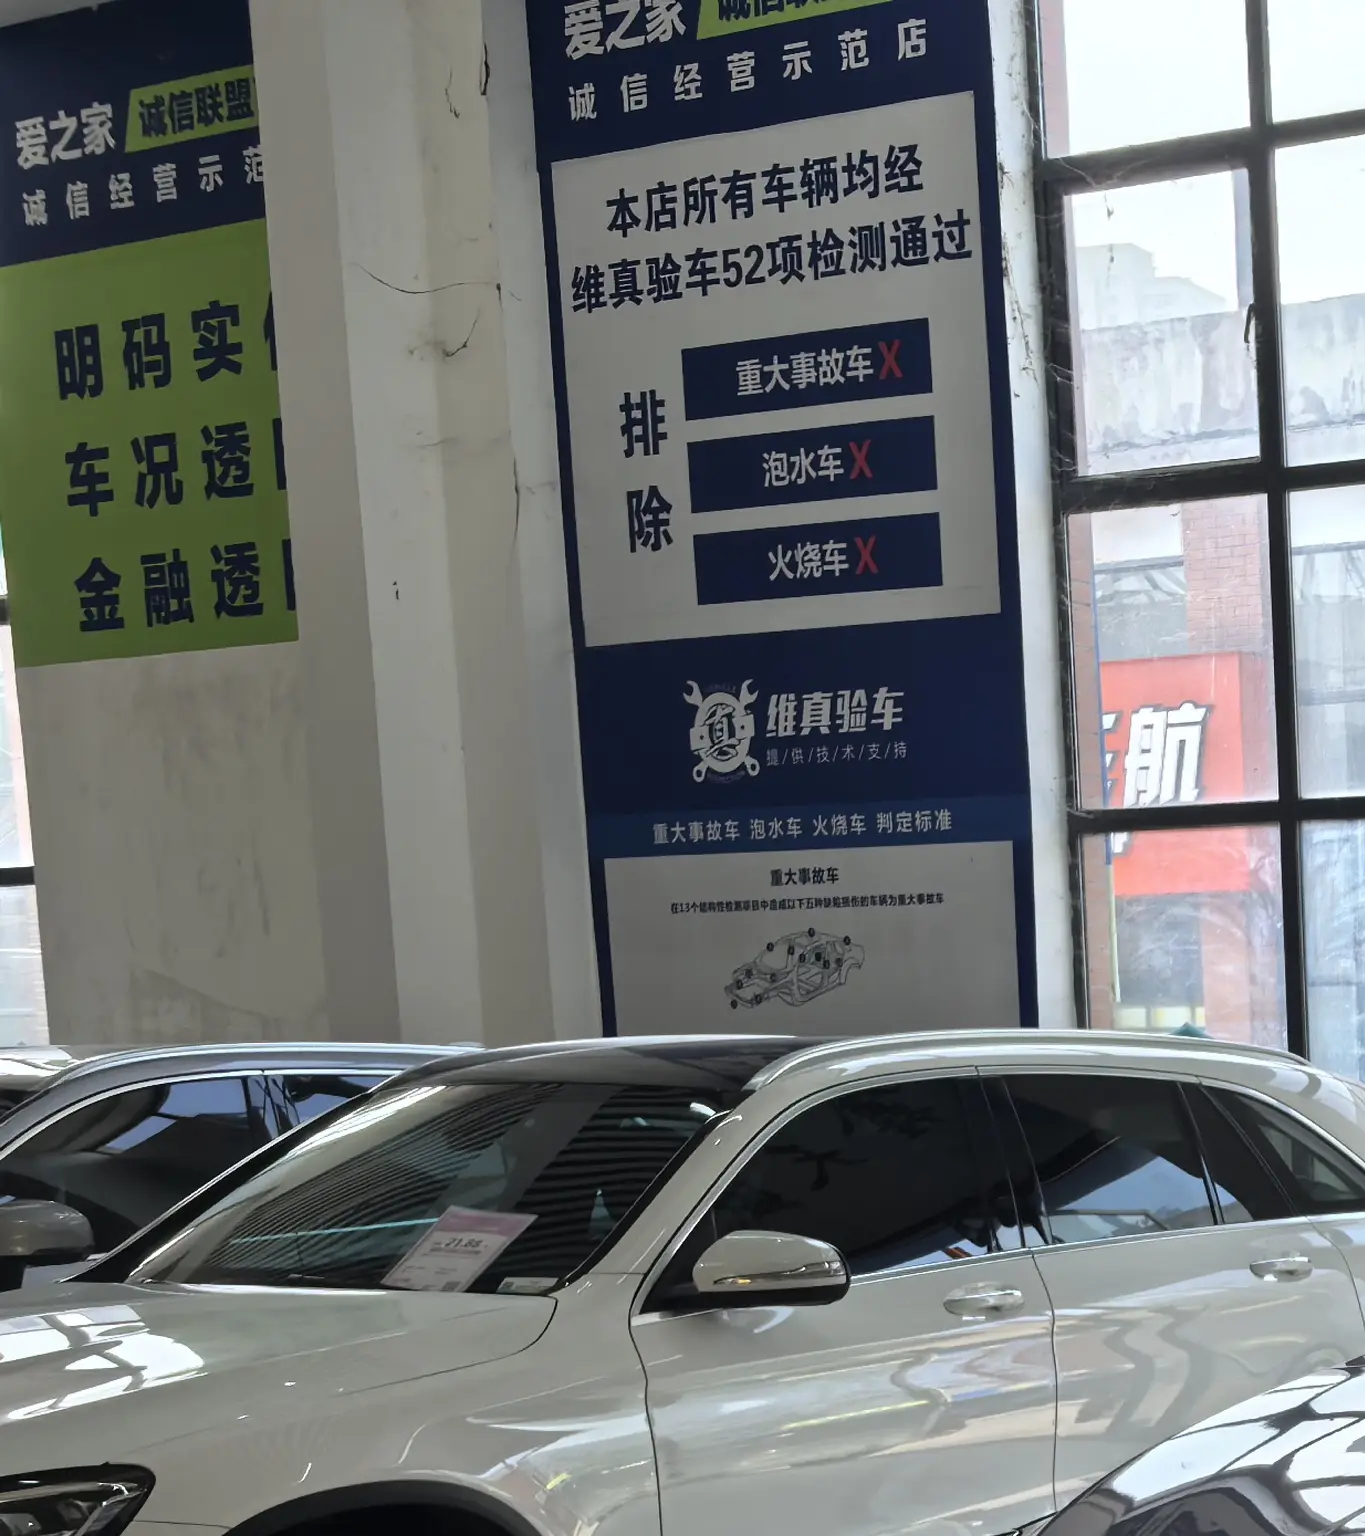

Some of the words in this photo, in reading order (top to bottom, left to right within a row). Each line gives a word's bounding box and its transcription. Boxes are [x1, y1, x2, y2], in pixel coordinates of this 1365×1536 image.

[563, 0, 687, 60] 爱之家
[567, 17, 928, 121] 诚信经营示范店
[14, 103, 117, 169] 爱之家
[138, 77, 255, 137] 诚信联盟
[22, 144, 264, 226] 诚信经营示范
[605, 143, 924, 238] 本店所有车辆均经
[570, 208, 973, 314] 维真验车52项检测通过
[53, 290, 279, 400] 明码实
[735, 345, 874, 396] 重大事故车
[64, 418, 287, 518] 车况透
[619, 389, 674, 553] 排除
[762, 444, 845, 488] 泡水车
[73, 537, 296, 632] 金融透
[768, 541, 850, 581] 火烧车
[766, 686, 905, 737] 维真验车
[1101, 701, 1211, 808] 航
[652, 819, 741, 844] 重大事故车
[749, 817, 803, 840] 泡水车
[812, 813, 867, 836] 火烧车
[876, 809, 952, 833] 判定标准
[770, 867, 840, 886] 重大事故车
